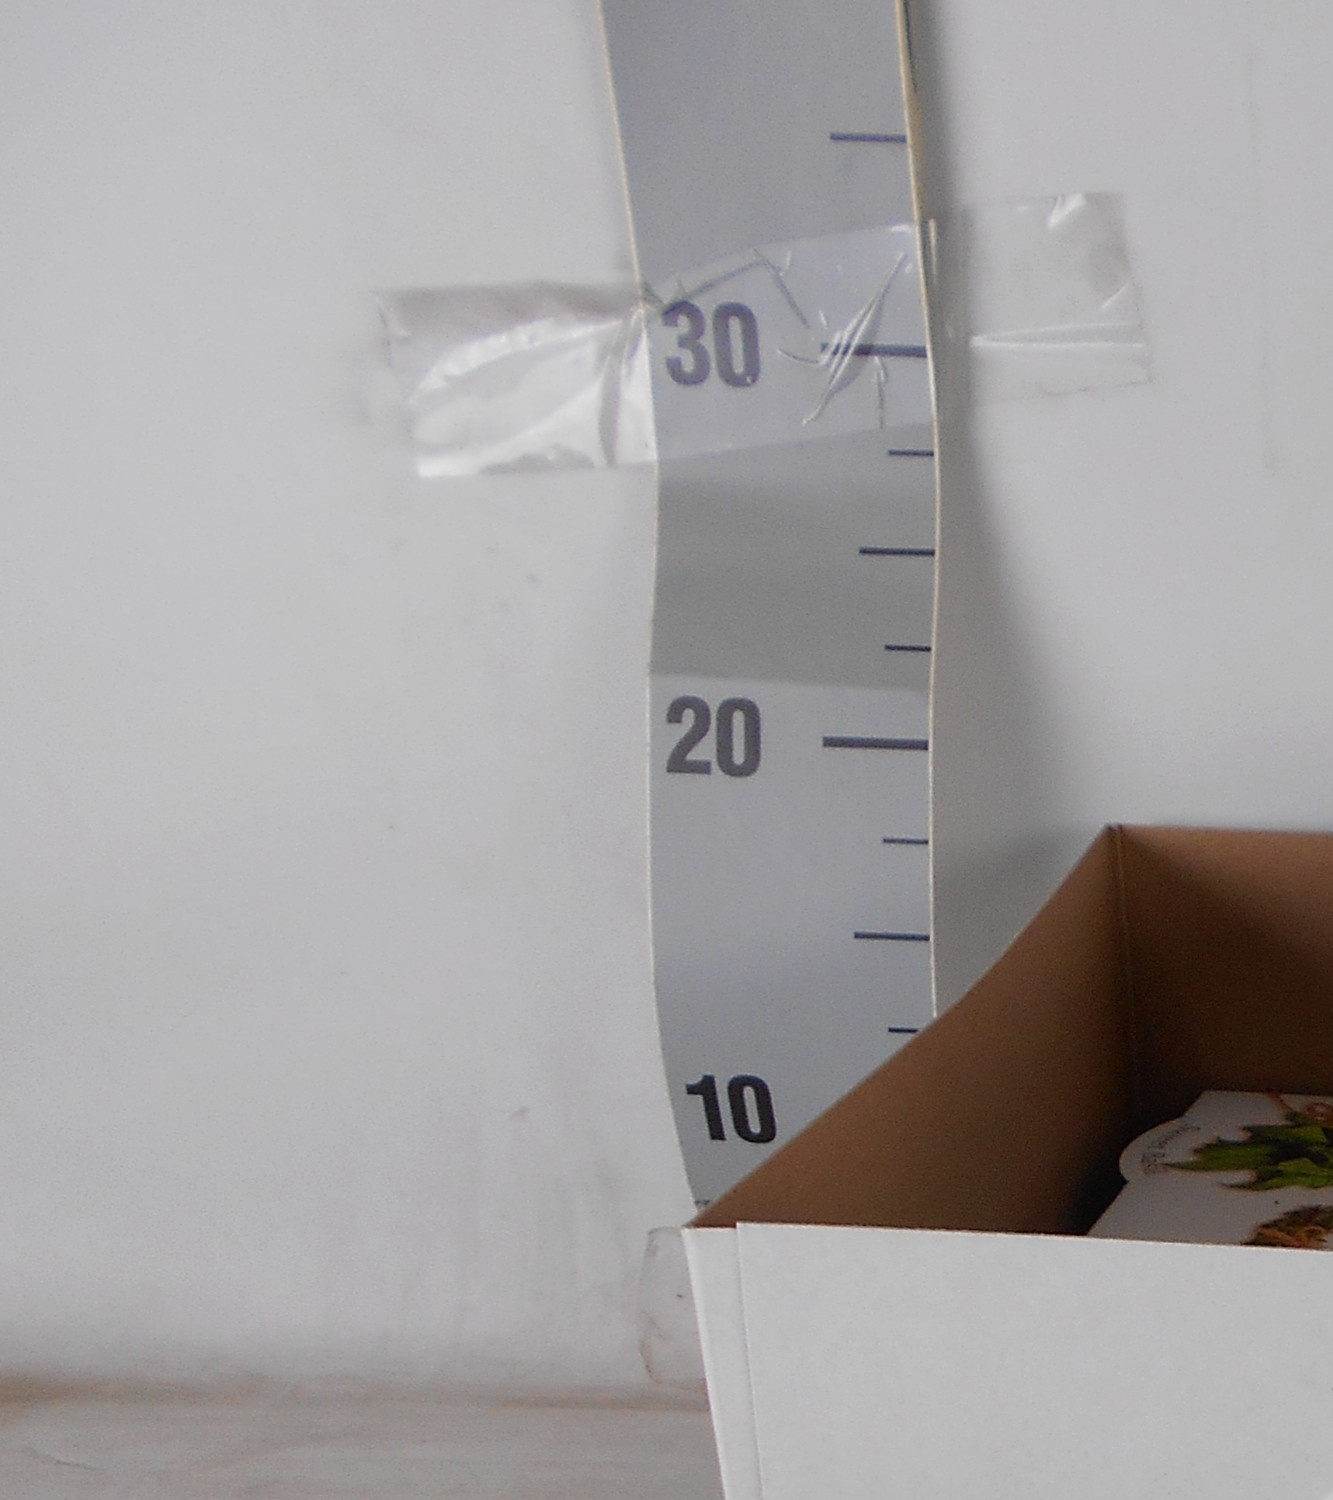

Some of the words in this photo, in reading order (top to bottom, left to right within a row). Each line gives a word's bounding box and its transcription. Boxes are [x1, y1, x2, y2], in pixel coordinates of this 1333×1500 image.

[662, 300, 762, 388] 30
[665, 695, 763, 779] 20
[685, 1074, 778, 1145] 10
